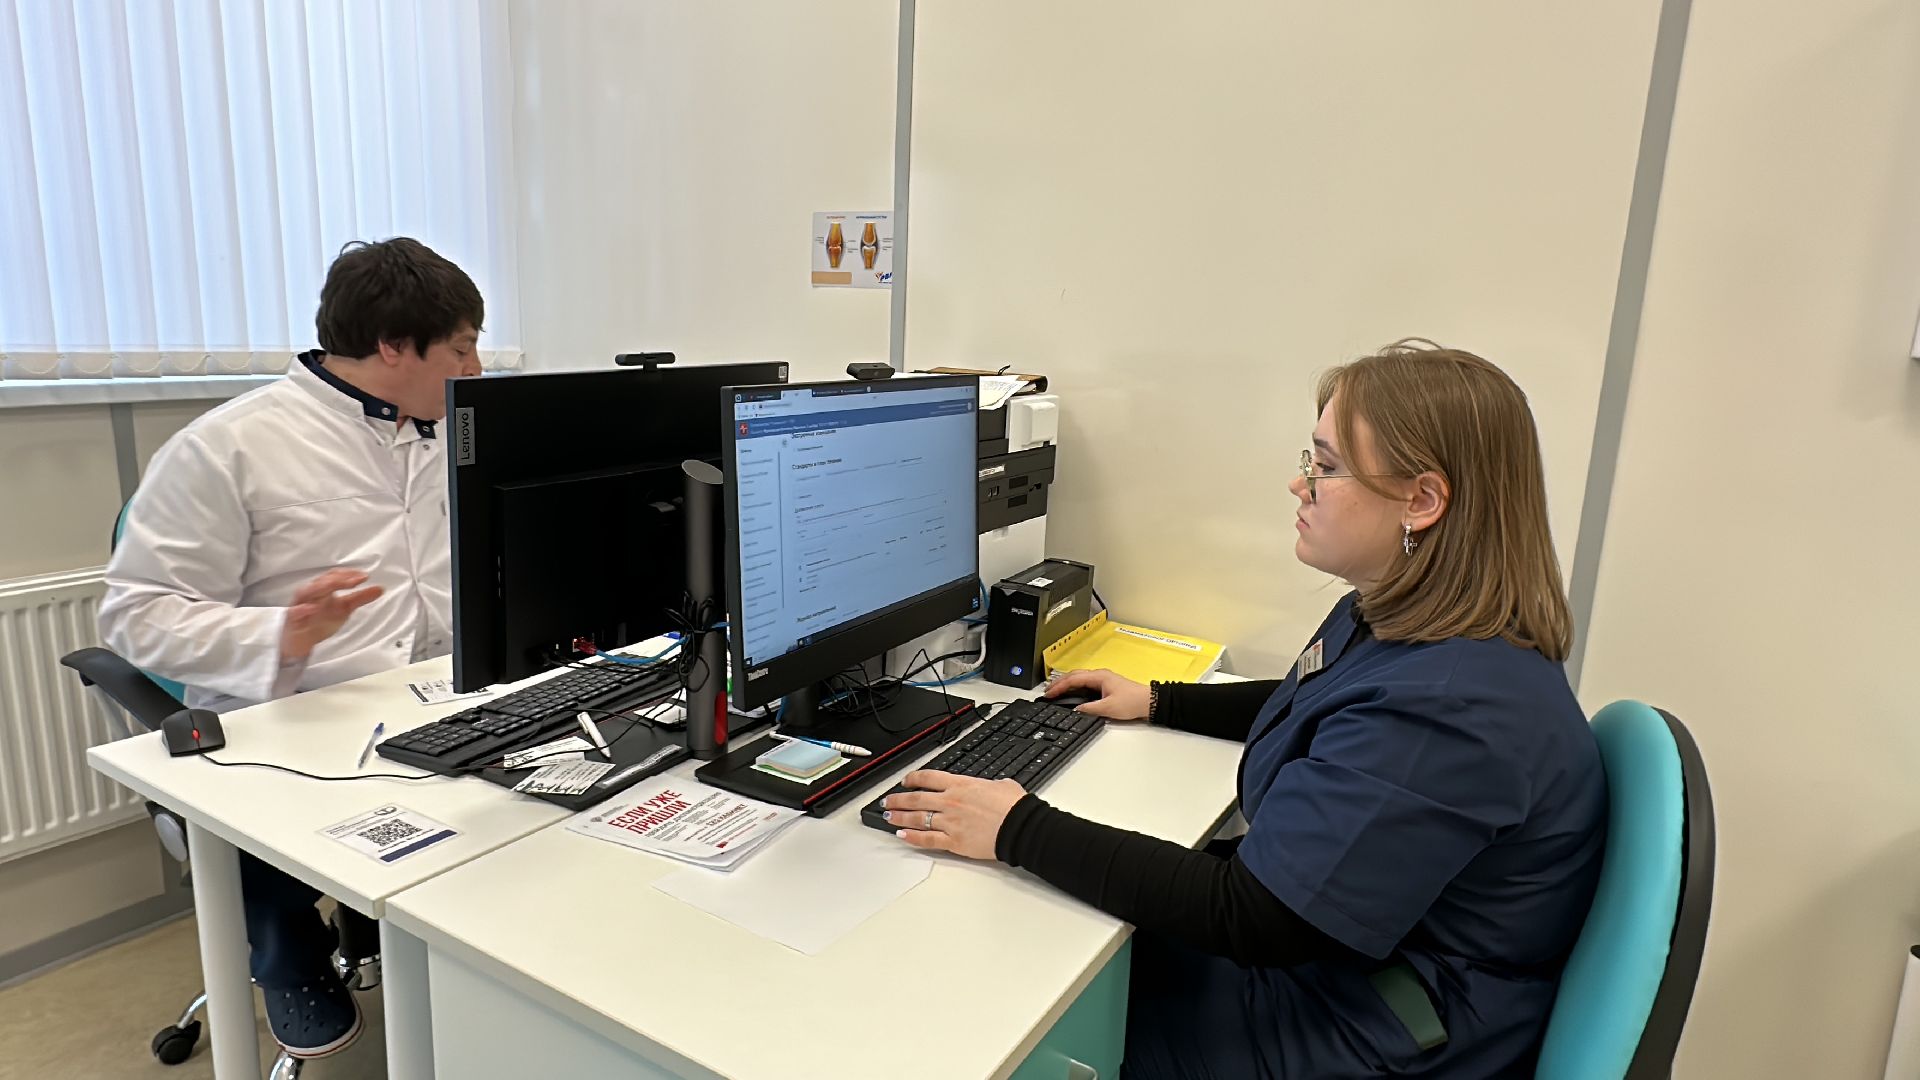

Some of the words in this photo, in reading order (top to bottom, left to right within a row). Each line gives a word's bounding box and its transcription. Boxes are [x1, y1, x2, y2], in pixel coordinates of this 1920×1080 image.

[461, 412, 470, 460] Lenovo
[607, 806, 653, 828] ЕСЛИ
[643, 789, 682, 808] УЖЕ
[626, 800, 692, 834] ПРИШЛИ
